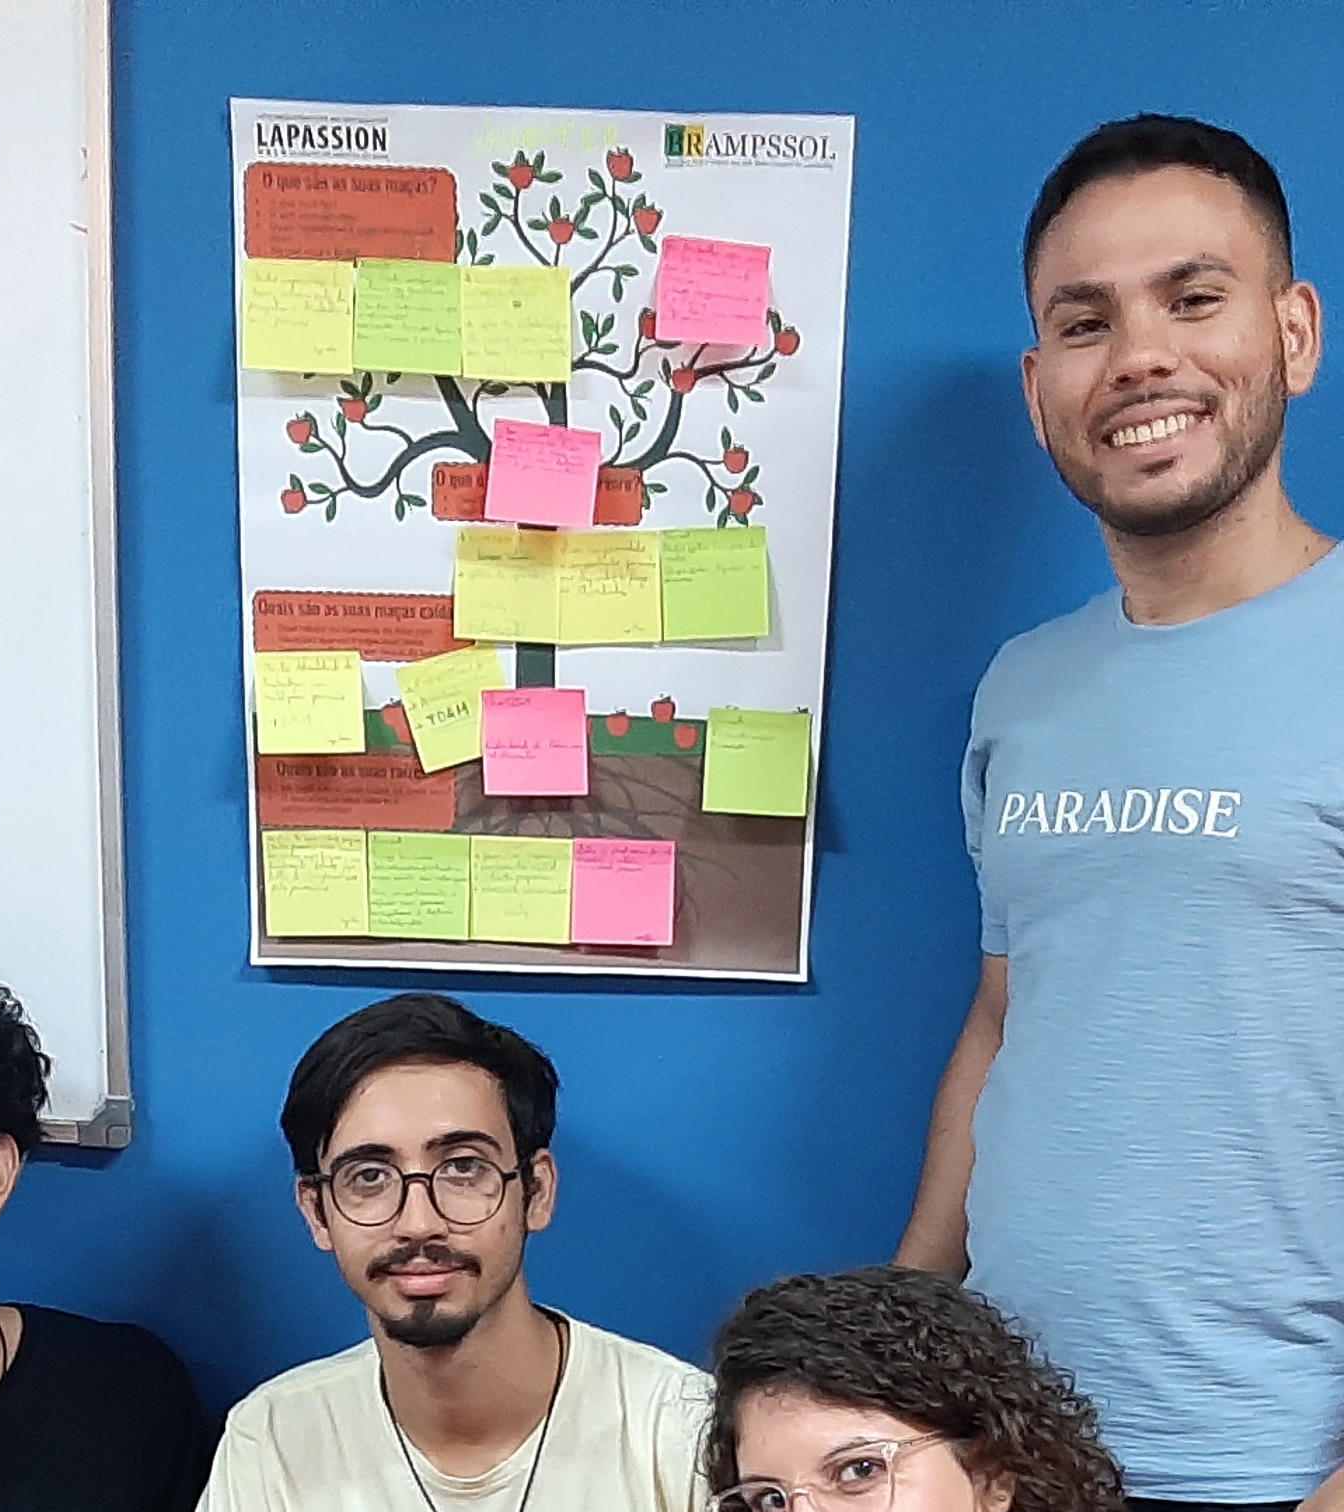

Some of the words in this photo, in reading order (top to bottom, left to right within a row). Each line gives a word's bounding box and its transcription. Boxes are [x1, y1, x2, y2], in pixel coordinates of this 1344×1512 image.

[257, 122, 387, 151] LAPASSION
[262, 171, 273, 190] O
[258, 598, 294, 616] Quais
[343, 604, 371, 617] suas
[998, 788, 1242, 838] PARADISE
